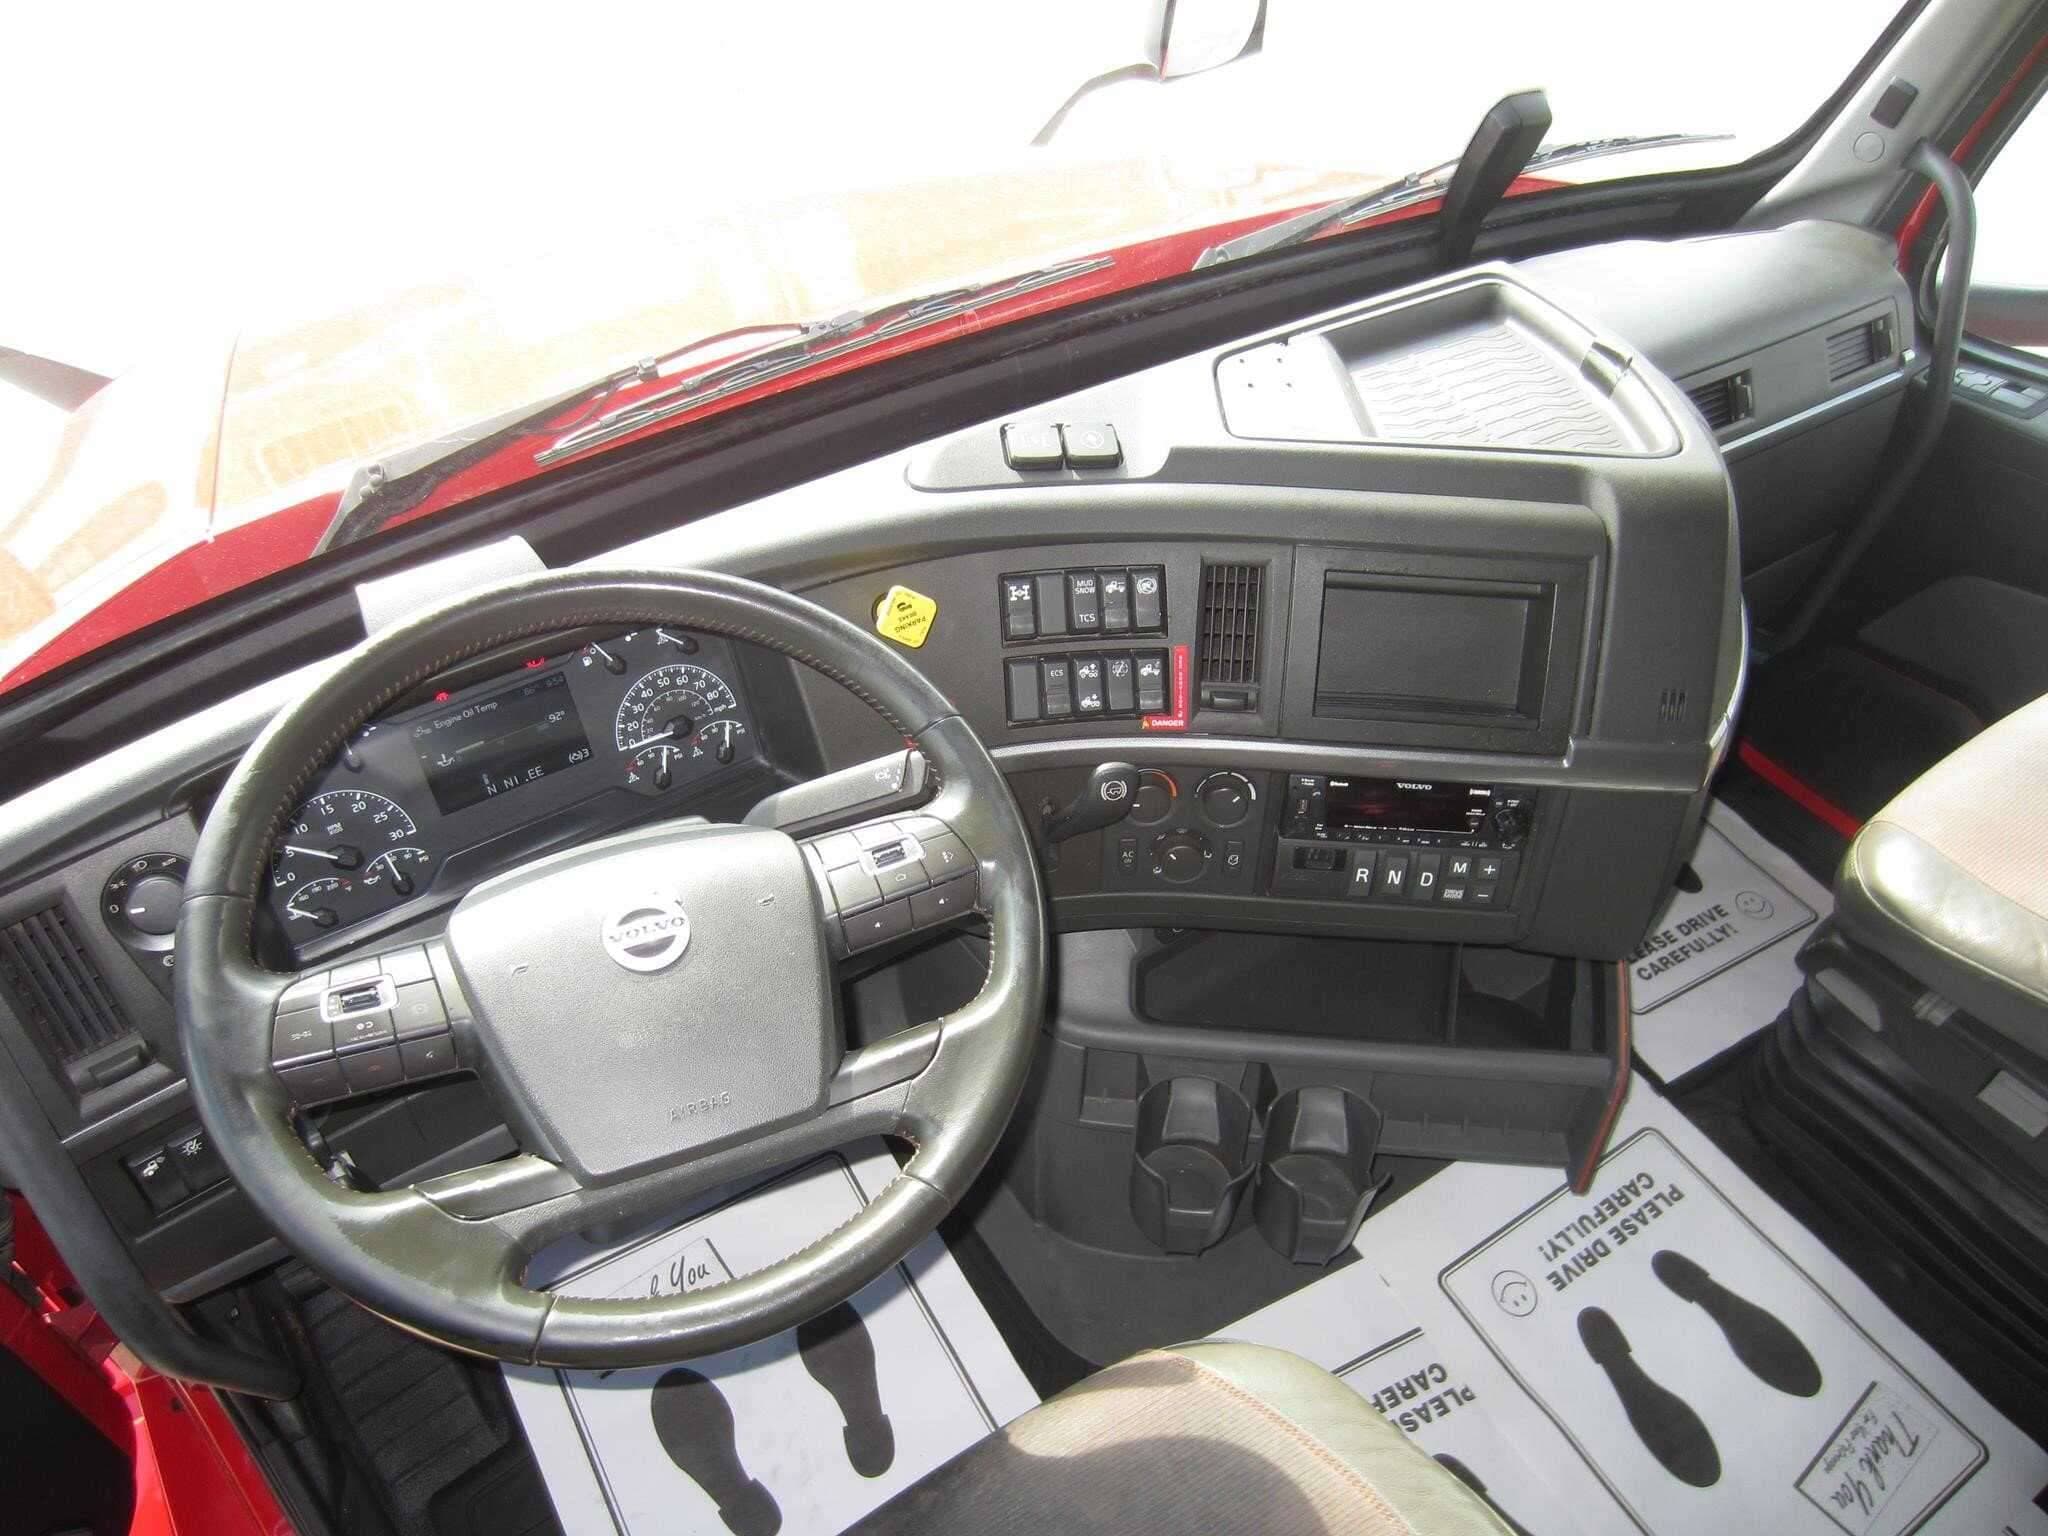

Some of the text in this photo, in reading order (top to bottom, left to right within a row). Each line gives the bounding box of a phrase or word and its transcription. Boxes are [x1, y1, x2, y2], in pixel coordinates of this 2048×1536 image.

[1076, 579, 1094, 587] MUD
[1074, 586, 1096, 595] SNOW
[1079, 613, 1096, 623] TCS
[1050, 669, 1064, 677] ECS
[656, 676, 670, 688] 50
[675, 674, 689, 686] 60
[693, 680, 706, 691] 70
[640, 688, 654, 699] 40
[706, 690, 719, 701] 80
[632, 703, 645, 715] 30
[433, 702, 498, 729] Engine Oil Temp
[626, 720, 639, 732] 20
[1151, 719, 1185, 727] DANGER
[1396, 782, 1433, 791] VOLVO
[320, 804, 335, 816] 15
[351, 801, 367, 813] 20
[373, 811, 389, 824] 25
[294, 823, 309, 835] 10
[389, 829, 404, 841] 30
[1453, 862, 1468, 873] M
[287, 872, 296, 881] 0
[1355, 867, 1369, 883] R
[1387, 869, 1402, 884] N
[1420, 872, 1434, 887] D
[608, 916, 685, 943] VOLVO
[1626, 904, 1729, 964] LEASE DRIVE
[1636, 922, 1740, 981] CAREFULLY!
[669, 1090, 731, 1121] AIRBAG
[1537, 1171, 1655, 1262] CAREFULLY!
[1545, 1183, 1686, 1292] PLEASE DRIVE
[670, 1255, 711, 1292] You
[1371, 1362, 1448, 1414] CAREF
[1390, 1384, 1477, 1433] PLEAS
[1858, 1411, 1919, 1491] Thank
[1830, 1471, 1875, 1516] You
